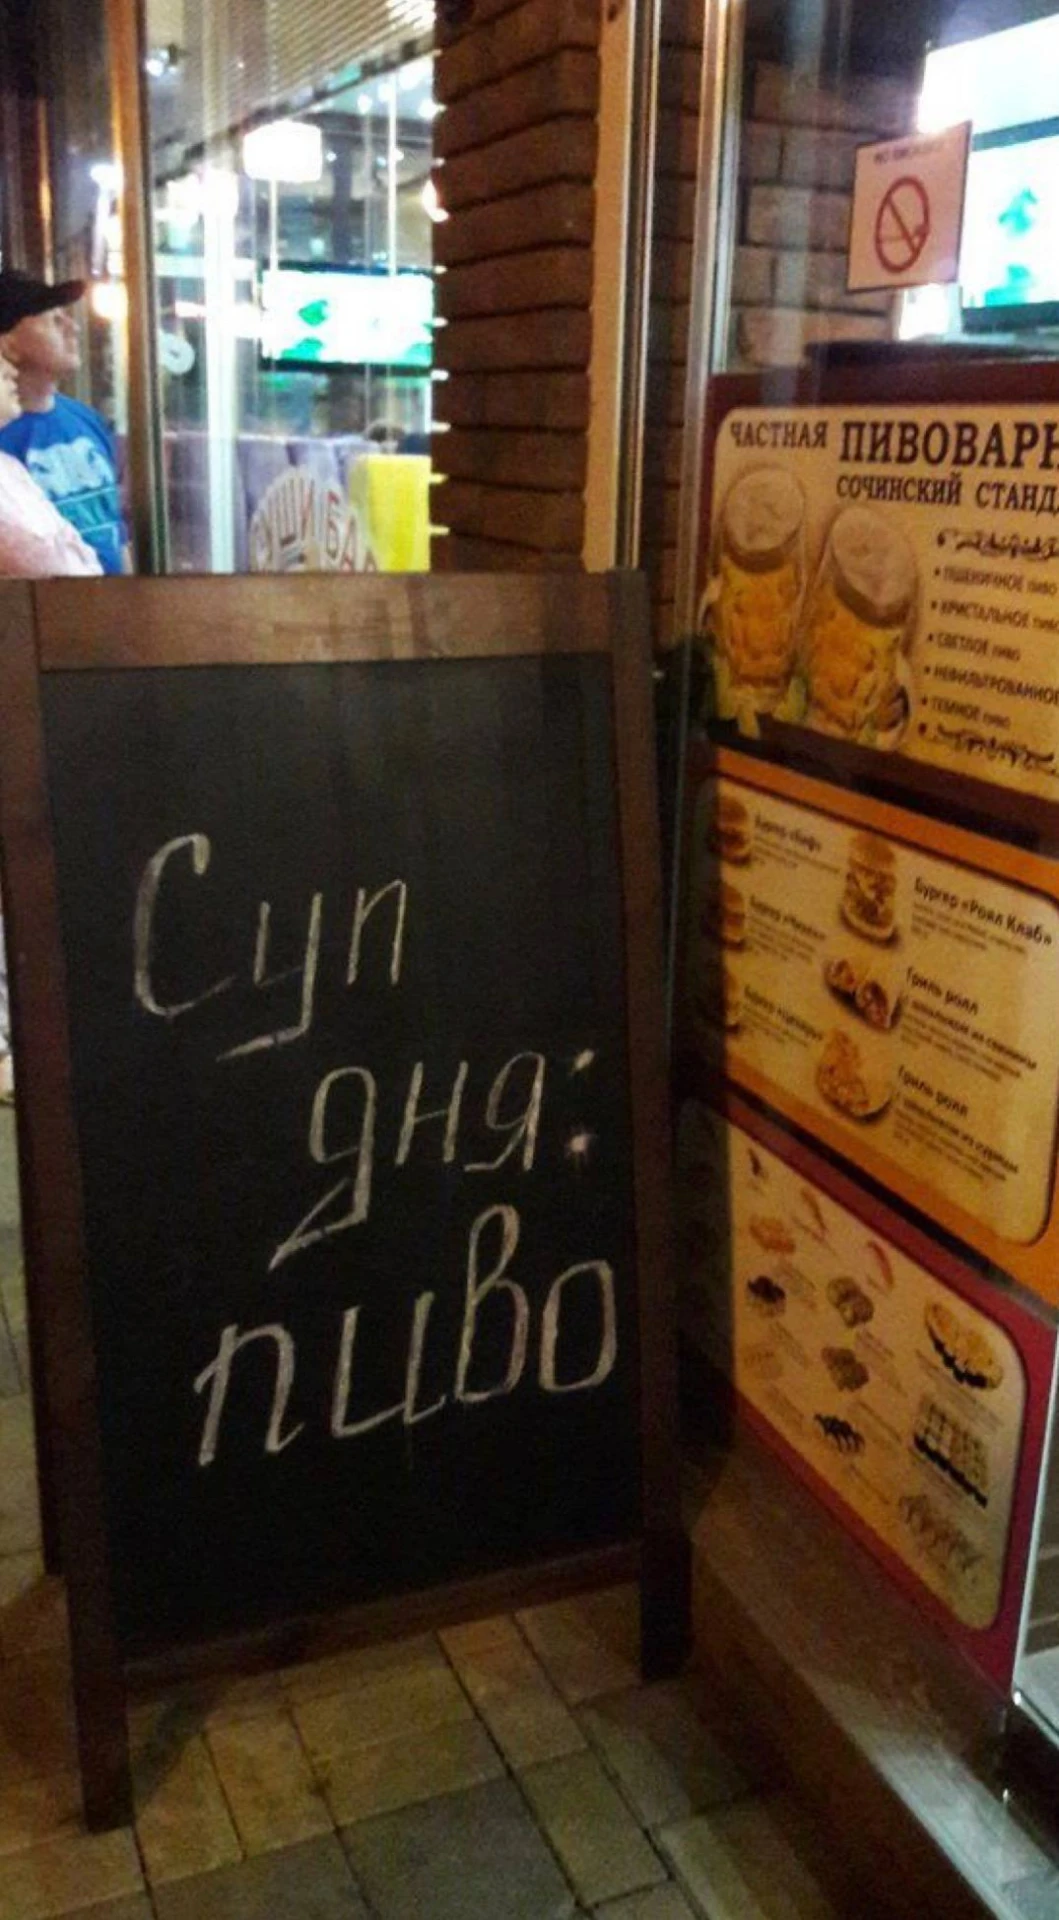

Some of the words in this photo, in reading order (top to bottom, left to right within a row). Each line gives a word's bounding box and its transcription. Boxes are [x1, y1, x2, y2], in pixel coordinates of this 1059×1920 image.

[730, 420, 829, 450] ЧАСТНАЯ
[836, 472, 962, 506] СОЧИНСКИЙ
[914, 876, 958, 909] Бургер
[133, 833, 407, 1062] Суп
[906, 966, 942, 998] Гриль
[193, 1204, 618, 1467] пиво
